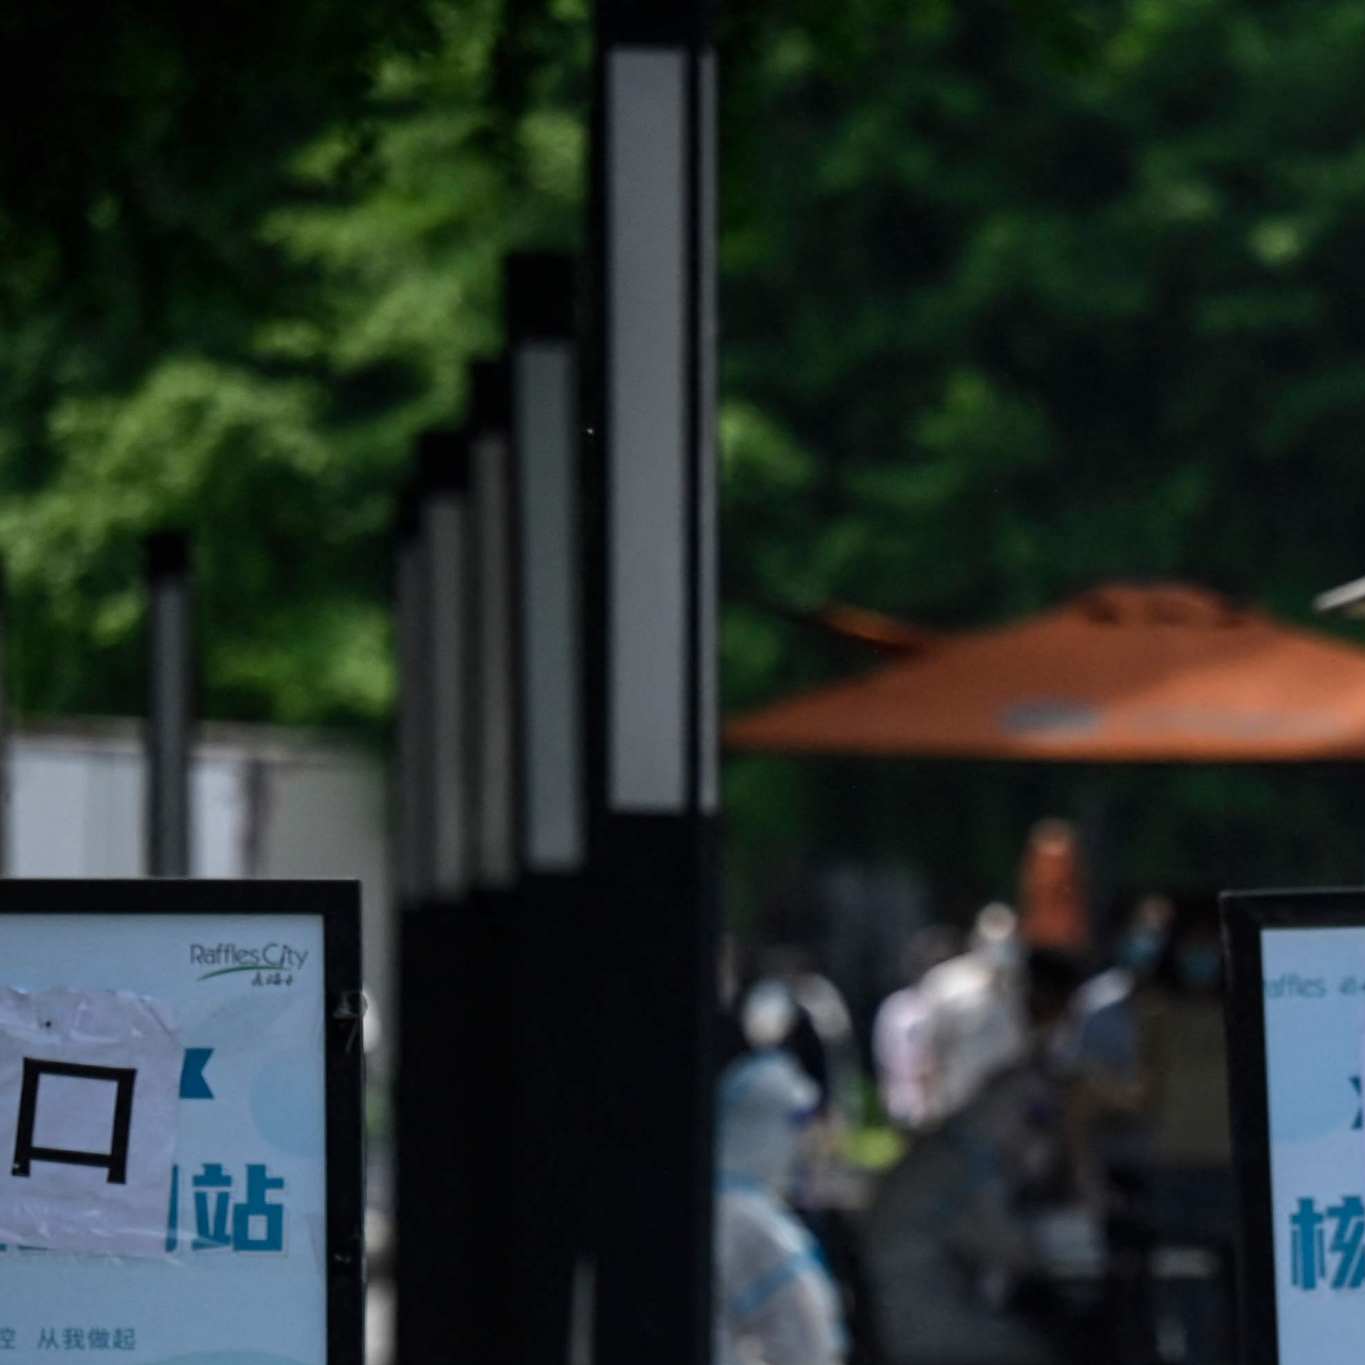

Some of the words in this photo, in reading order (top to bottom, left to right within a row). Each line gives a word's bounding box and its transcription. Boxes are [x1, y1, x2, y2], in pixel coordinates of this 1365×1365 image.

[11, 1057, 136, 1185] 口
[37, 1326, 136, 1352] 从我做起
